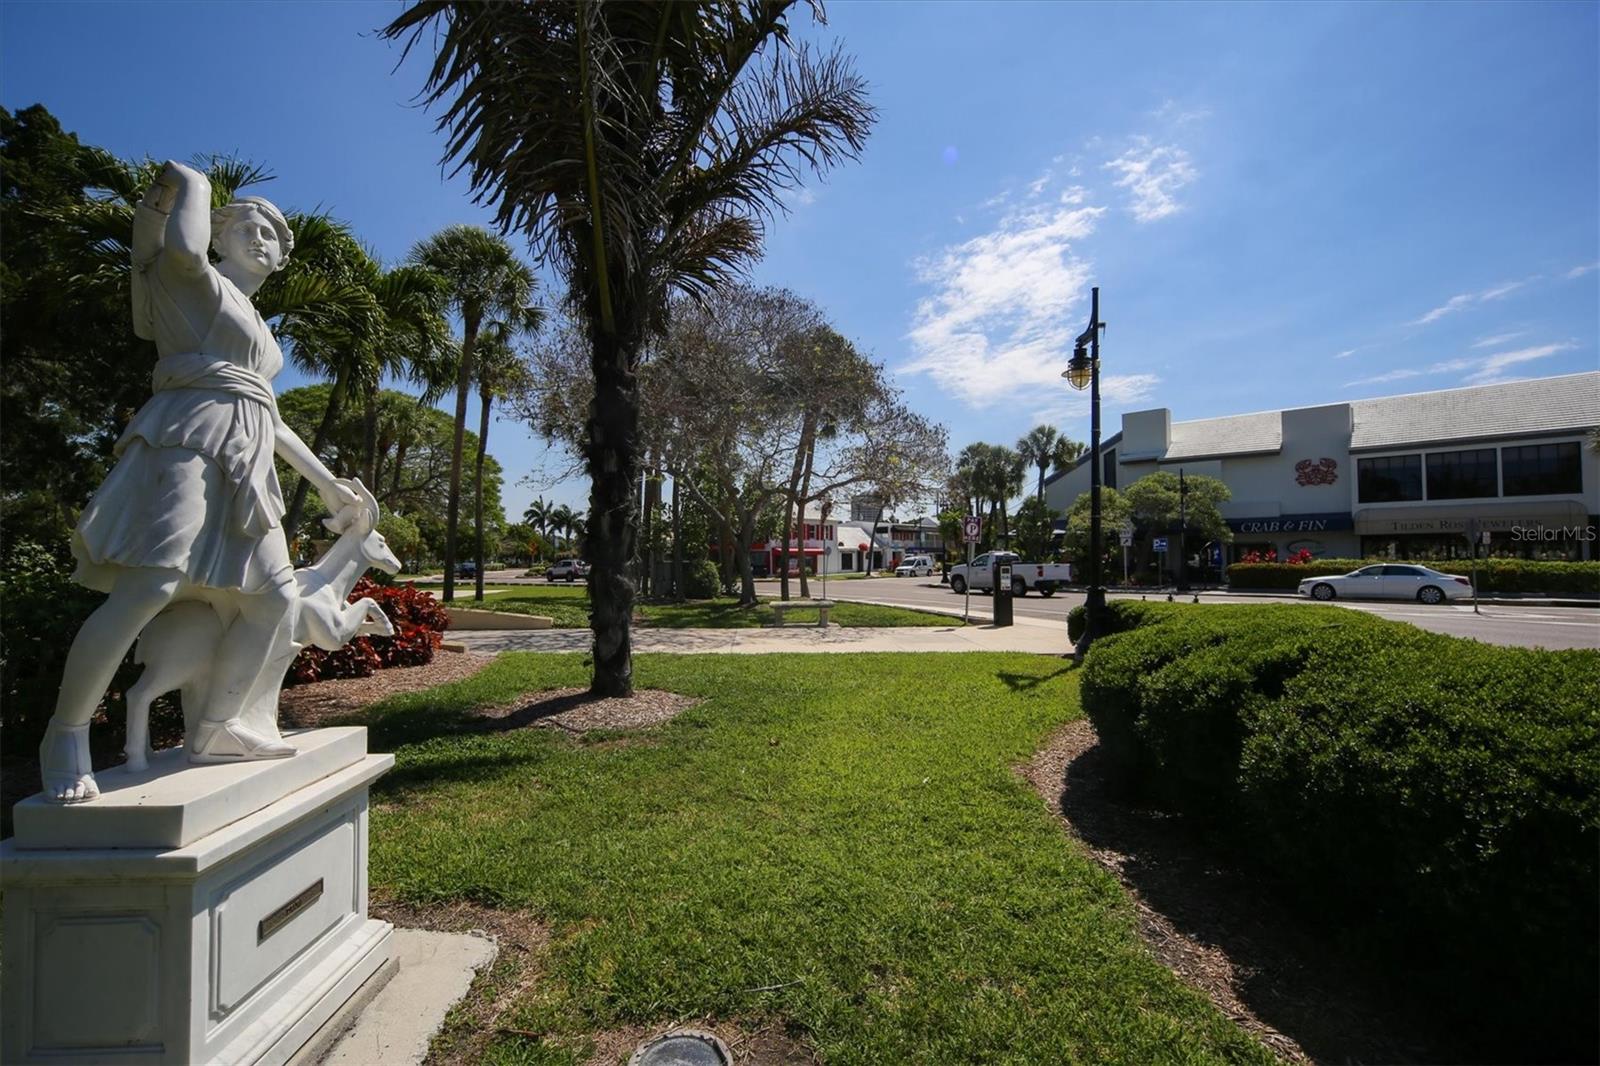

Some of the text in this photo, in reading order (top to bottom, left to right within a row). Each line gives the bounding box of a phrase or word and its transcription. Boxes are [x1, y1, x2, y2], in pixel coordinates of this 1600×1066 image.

[1240, 519, 1327, 532] CRAB & FIN
